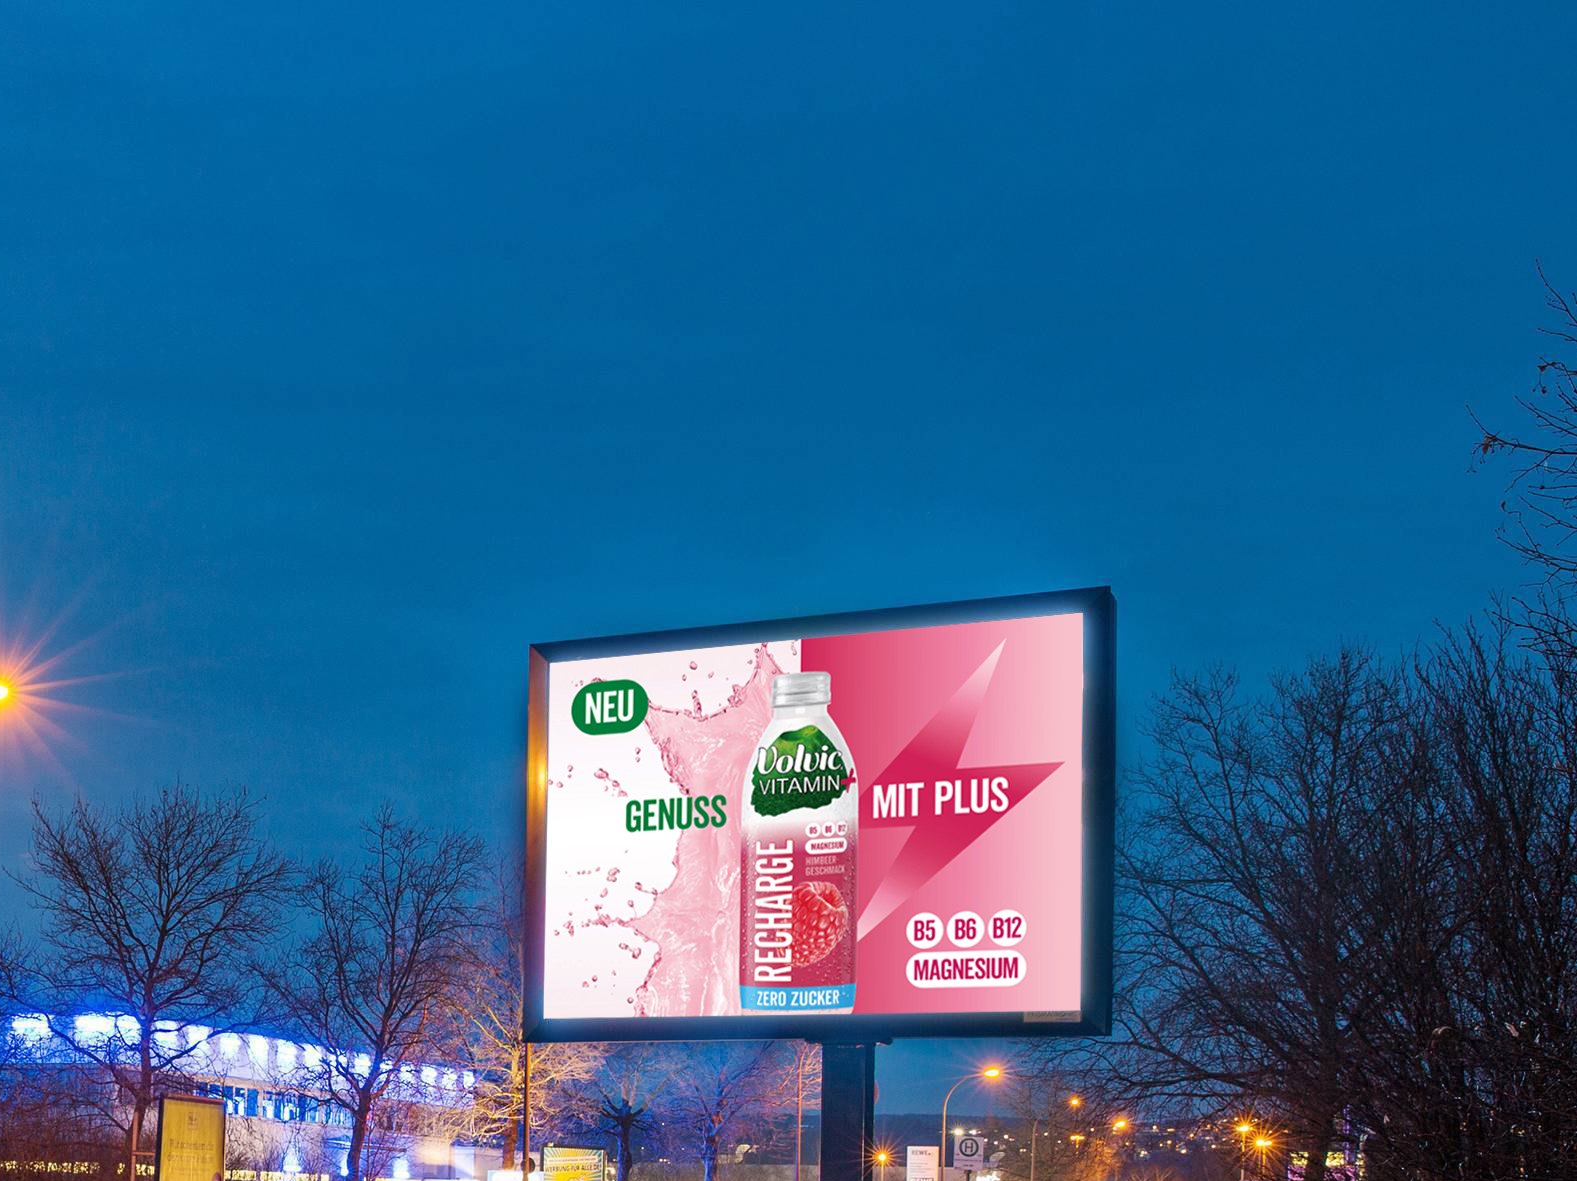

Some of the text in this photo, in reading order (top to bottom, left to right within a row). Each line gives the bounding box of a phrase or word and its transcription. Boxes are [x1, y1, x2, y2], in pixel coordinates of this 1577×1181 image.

[585, 689, 634, 724] NEU
[757, 743, 843, 775] Volvic
[873, 777, 1009, 818] MIT PLUS
[626, 795, 727, 833] GENUSS
[810, 841, 845, 851] MAGNESIUM
[754, 840, 794, 982] RECHARGE
[914, 916, 1022, 941] B5 B6 B12
[914, 957, 1019, 981] MAGNESIUM
[756, 990, 840, 1006] ZERO ZUCKER
[965, 1142, 973, 1153] H
